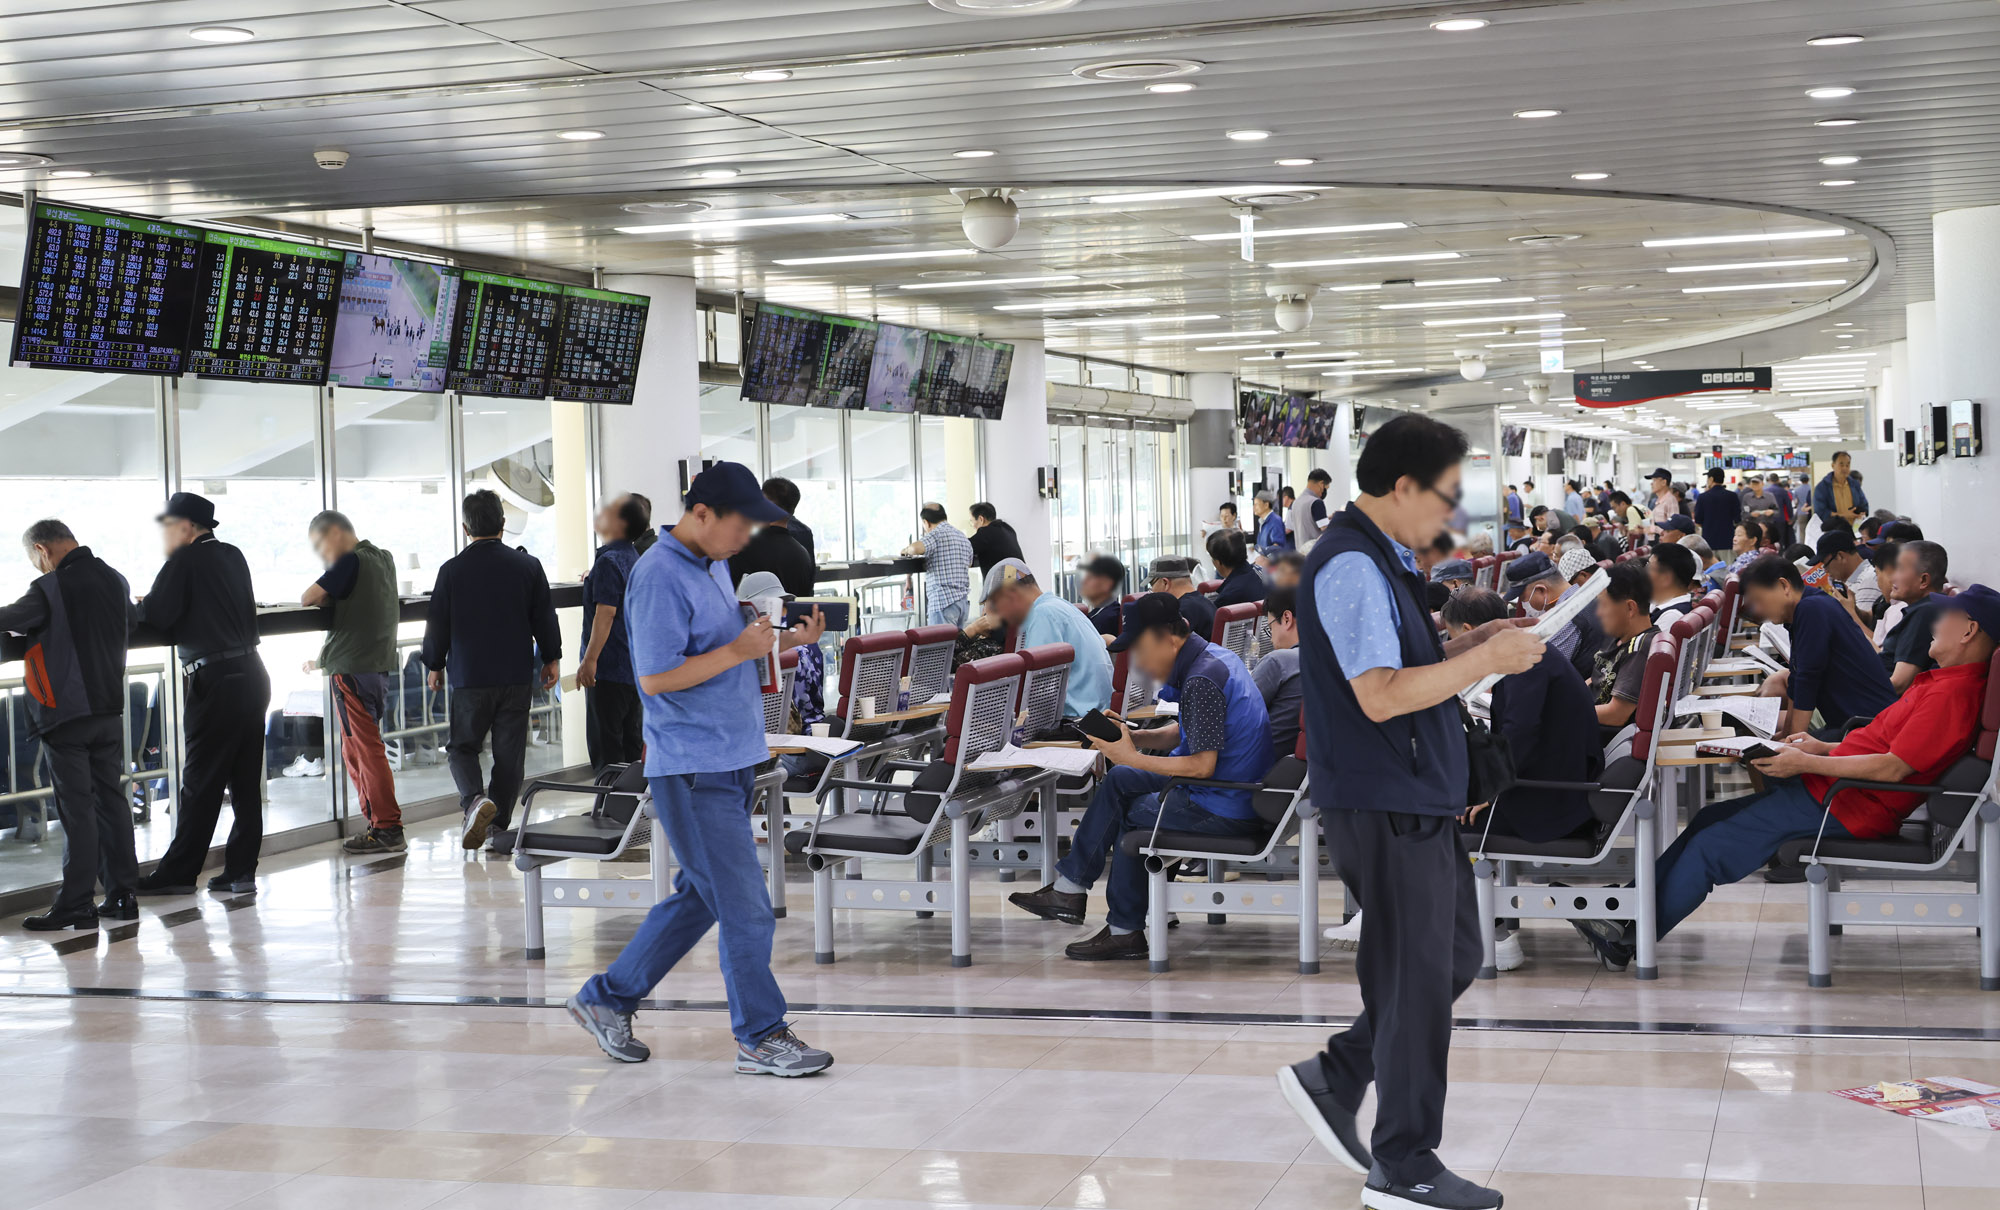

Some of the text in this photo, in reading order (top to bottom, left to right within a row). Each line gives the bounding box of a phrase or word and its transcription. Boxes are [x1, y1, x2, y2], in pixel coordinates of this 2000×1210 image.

[47, 227, 62, 236] 492.9
[240, 265, 248, 273] 4.3
[95, 280, 111, 288] 1511.2
[38, 289, 53, 297] 572.4
[65, 307, 79, 315] 915.7
[243, 343, 253, 351] 12.1
